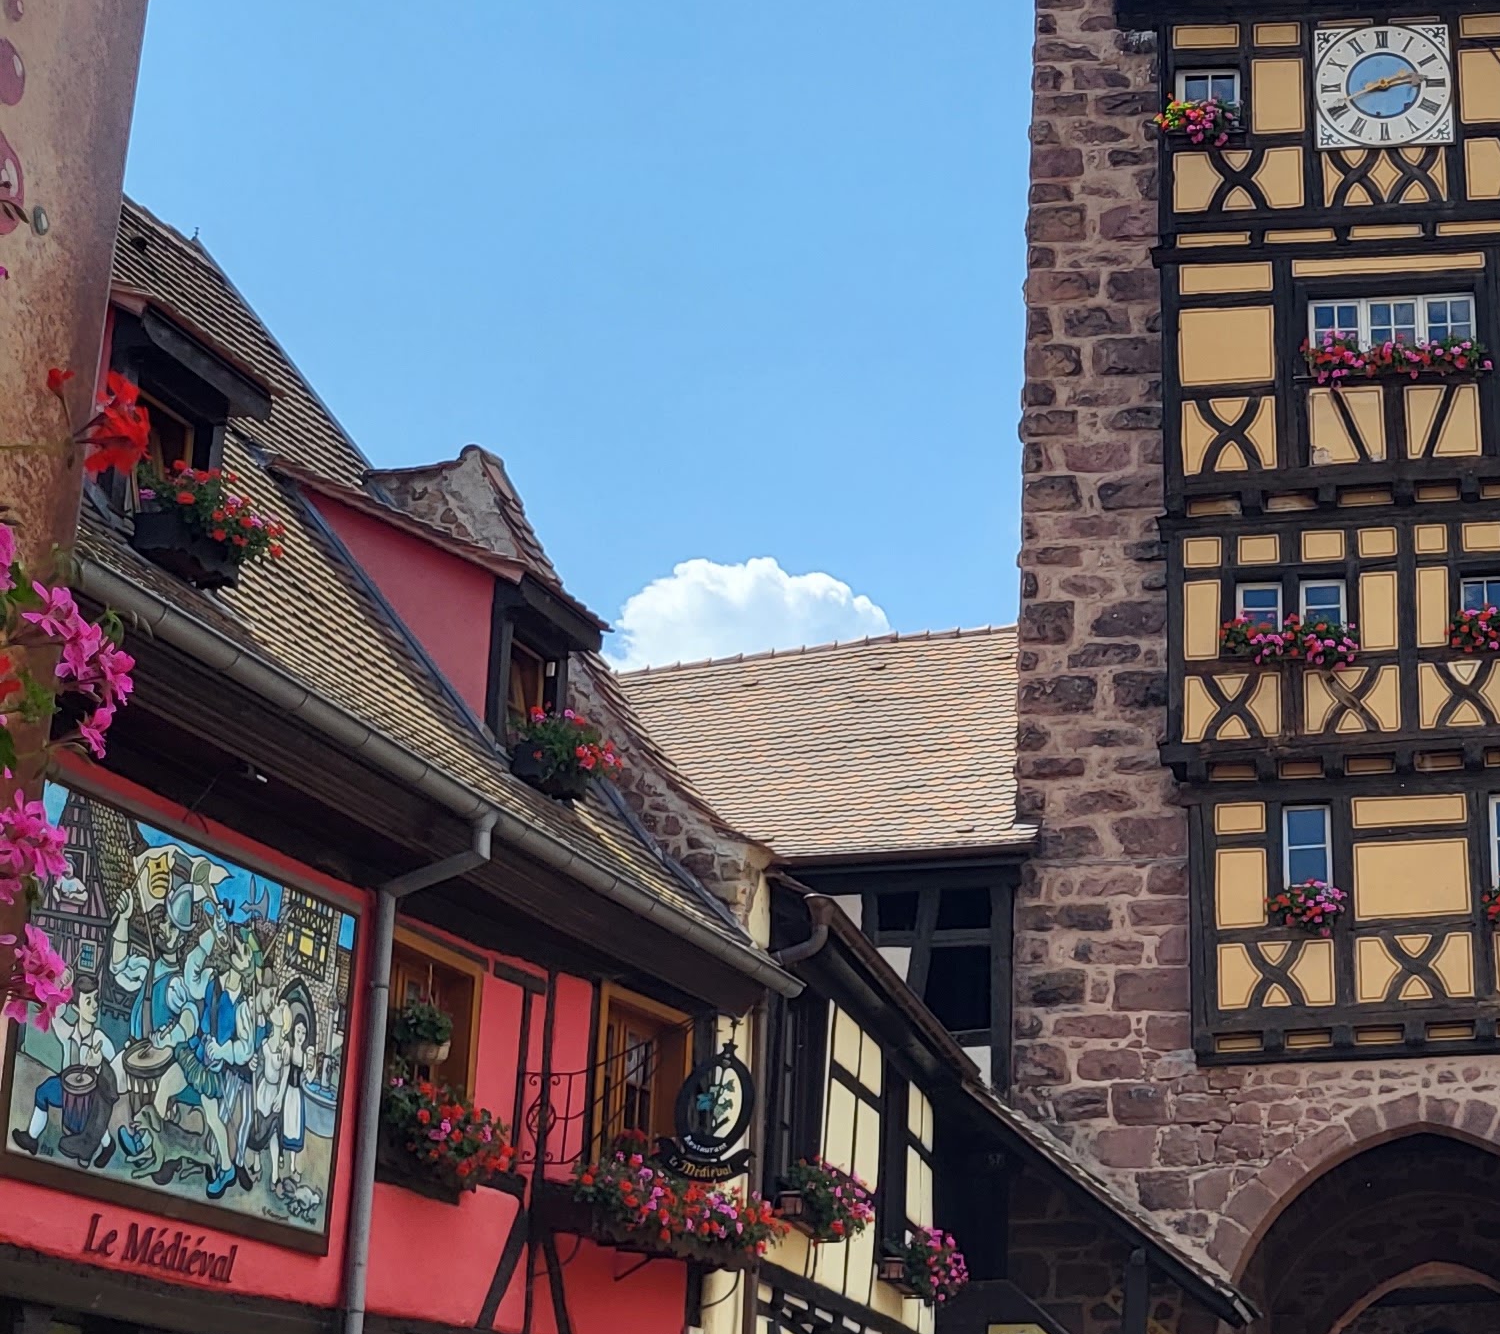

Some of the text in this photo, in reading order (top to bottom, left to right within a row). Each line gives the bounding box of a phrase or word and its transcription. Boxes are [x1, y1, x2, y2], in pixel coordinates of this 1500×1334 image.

[683, 1134, 728, 1154] Restaurant
[83, 1213, 239, 1283] Le Médiéval
